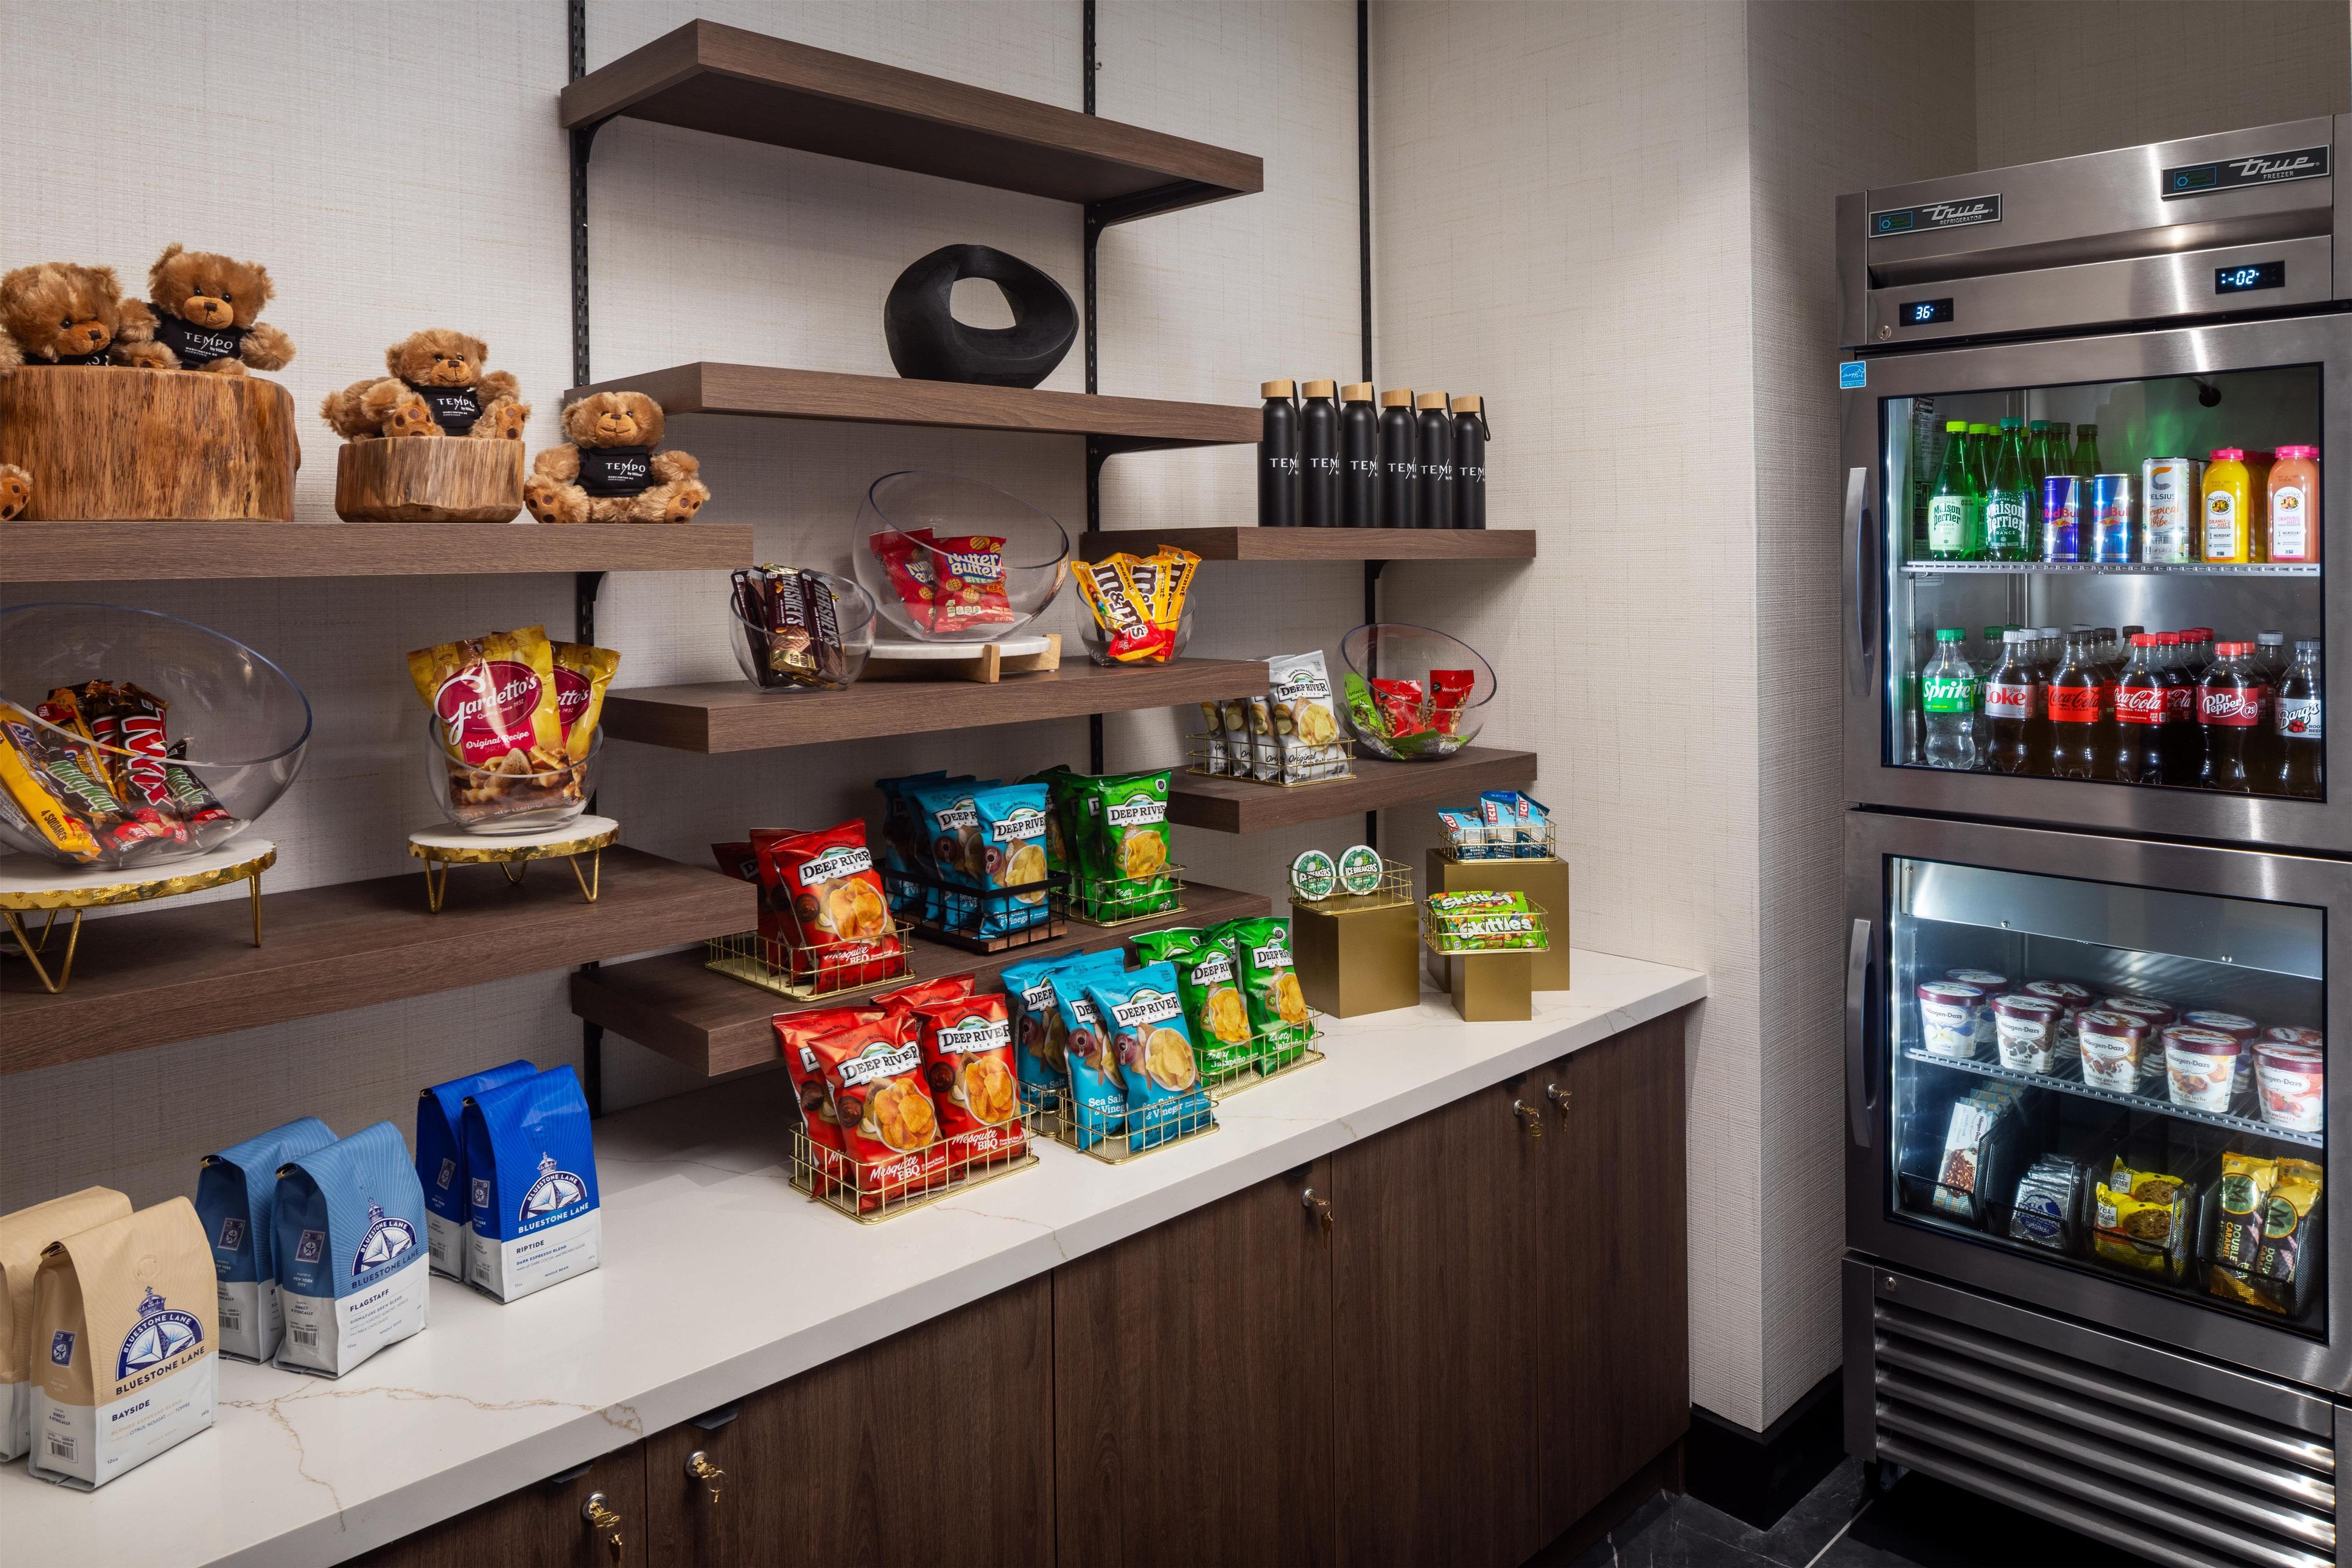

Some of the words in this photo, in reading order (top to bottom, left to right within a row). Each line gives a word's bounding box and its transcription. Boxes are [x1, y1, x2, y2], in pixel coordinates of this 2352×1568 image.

[2264, 171, 2294, 179] FREEZER
[1940, 215, 1982, 225] REFRIGERATOR
[184, 331, 233, 350] TEMPO
[606, 459, 646, 475] TEMPO
[1987, 500, 2025, 519] Maison
[2044, 507, 2060, 519] Red
[2148, 501, 2180, 518] Tropical
[2149, 516, 2169, 527] Vibe
[948, 552, 1000, 566] Nutter
[951, 562, 1002, 578] Butter
[1117, 561, 1133, 594] peanut
[1179, 562, 1194, 597] peanut
[814, 582, 840, 648] HERSHEY'S
[790, 653, 799, 665] SIZE
[799, 653, 809, 667] KING
[1281, 684, 1305, 697] DEEP
[1305, 682, 1327, 693] RIVER
[1923, 680, 1971, 702] Sprite
[1985, 684, 2026, 706] Coke
[499, 705, 513, 714] Since
[513, 698, 524, 707] 1932
[2049, 688, 2100, 709] Coca-Cola
[2205, 694, 2244, 715] Pepper
[2215, 693, 2232, 704] Dr
[434, 674, 538, 746] Gardetto's
[2279, 703, 2320, 730] Barq's
[466, 736, 501, 750] Original
[502, 730, 530, 743] Recipe
[121, 707, 176, 812] TWIX
[1289, 752, 1317, 763] Original
[940, 812, 968, 826] DEEP
[1110, 808, 1138, 821] DEEP
[1444, 815, 1457, 827] CLIF
[44, 813, 68, 843] SQUARES
[997, 821, 1024, 837] DEEP
[803, 858, 837, 880] DEEP
[842, 851, 870, 867] RIVER
[821, 864, 864, 880] SNACKS
[1345, 866, 1354, 876] ICE
[1353, 863, 1378, 873] BREAKERS
[1442, 893, 1514, 910] Skittles
[1006, 913, 1033, 925] Vinegar
[1458, 918, 1533, 939] Skittles
[1258, 949, 1280, 963] DEEP
[1194, 964, 1216, 980] DEEP
[1030, 990, 1054, 1006] DEEP
[1117, 1005, 1147, 1022] DEEP
[1148, 997, 1180, 1014] RIVER
[1134, 1011, 1173, 1023] SNACKS
[942, 1032, 973, 1048] DEEP
[973, 1023, 1010, 1042] RIVER
[2000, 1021, 2040, 1034] Häagen-Dazs
[1267, 1031, 1291, 1042] Zesty
[1272, 1038, 1303, 1051] Jalapeño
[2084, 1038, 2124, 1051] Häagen-Dazs
[960, 1040, 1000, 1050] SNACKS
[843, 1058, 881, 1081] DEEP
[884, 1045, 919, 1068] RIVER
[1205, 1050, 1229, 1061] Zesty
[1210, 1055, 1246, 1068] Jalapeño
[2008, 1056, 2032, 1065] chocolate
[2168, 1052, 2211, 1068] Häagen-Dazs
[865, 1061, 911, 1079] SNACKS
[1049, 1078, 1065, 1089] Salt
[1088, 1097, 1106, 1107] Sea
[1107, 1093, 1125, 1105] Salt
[1094, 1107, 1101, 1116] &
[1153, 1102, 1183, 1118] Vinegar
[951, 1129, 998, 1145] Mesquite
[977, 1137, 998, 1152] BBQ
[870, 1155, 918, 1182] Mesquite
[897, 1165, 921, 1182] BBQ
[527, 1174, 559, 1201] BLUESTONE
[560, 1174, 579, 1184] LANE
[518, 1211, 568, 1234] BLUESTONE
[570, 1202, 589, 1216] LANE
[360, 1221, 387, 1254] BLUESTONE
[389, 1221, 408, 1230] LANE
[2223, 1222, 2234, 1258] CARAMEL
[2230, 1224, 2242, 1262] DOUBLE
[516, 1240, 545, 1254] RIPTIDE
[529, 1250, 552, 1261] ESPRESSO
[552, 1245, 567, 1253] BLEND
[352, 1261, 401, 1289] BLUESTONE
[402, 1248, 420, 1264] LANE
[545, 1268, 558, 1278] WHOLE
[350, 1288, 390, 1312] FLAGSTAFF
[350, 1310, 376, 1324] SIGNATURE
[377, 1303, 389, 1313] BREW
[389, 1295, 403, 1305] BLEND
[123, 1314, 167, 1354] BLUESTONE
[169, 1314, 192, 1325] LANE
[379, 1325, 393, 1335] WHOLE
[393, 1319, 402, 1328] BEAN
[116, 1360, 178, 1396] BLUESTONE
[181, 1346, 206, 1365] LANE
[53, 1411, 66, 1420] DIRECT
[111, 1399, 151, 1422] BAYSIDE
[129, 1425, 146, 1436] CITRUS,
[147, 1414, 166, 1427] NOUGAT,
[175, 1401, 191, 1412] TOFFEE
[51, 1415, 70, 1426] ETHICALLY
[111, 1422, 135, 1436] BLONDE
[137, 1408, 165, 1425] ESPRESSO
